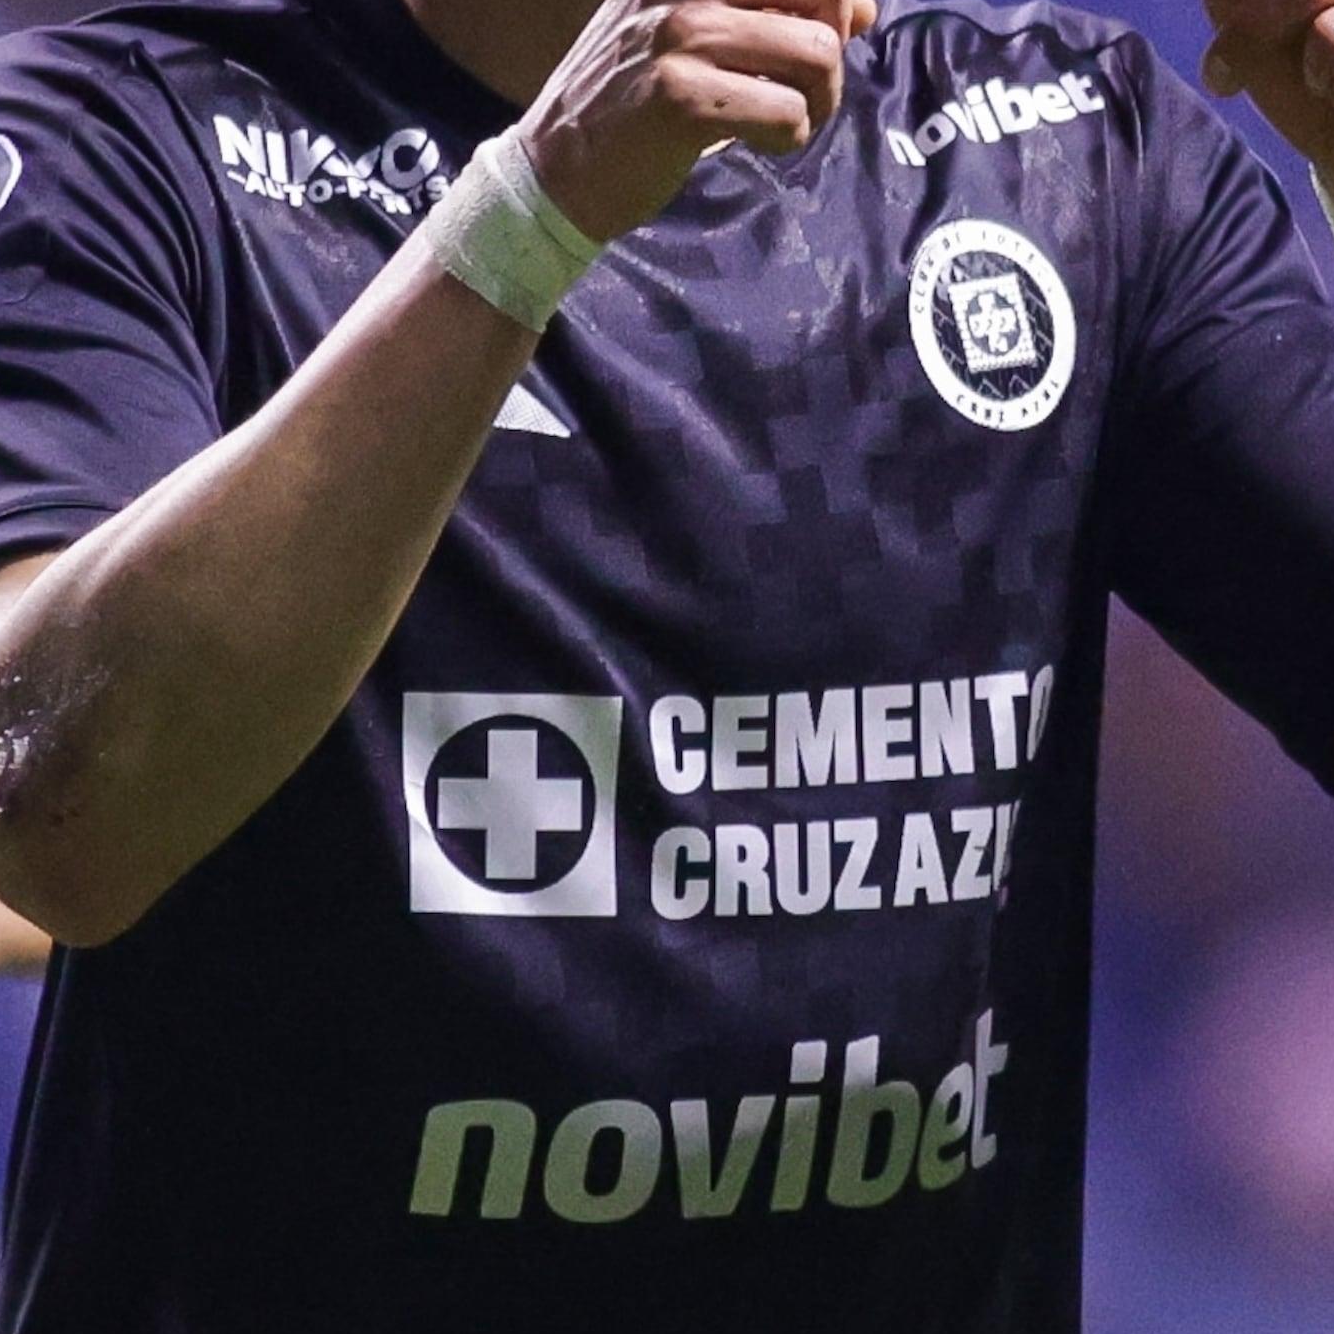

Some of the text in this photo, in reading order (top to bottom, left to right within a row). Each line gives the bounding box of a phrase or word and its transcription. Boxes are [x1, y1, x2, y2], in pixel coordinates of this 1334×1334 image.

[886, 71, 1105, 166] novibet
[650, 799, 1021, 920] CRUZ AZU
[409, 1007, 1009, 1223] novibet
